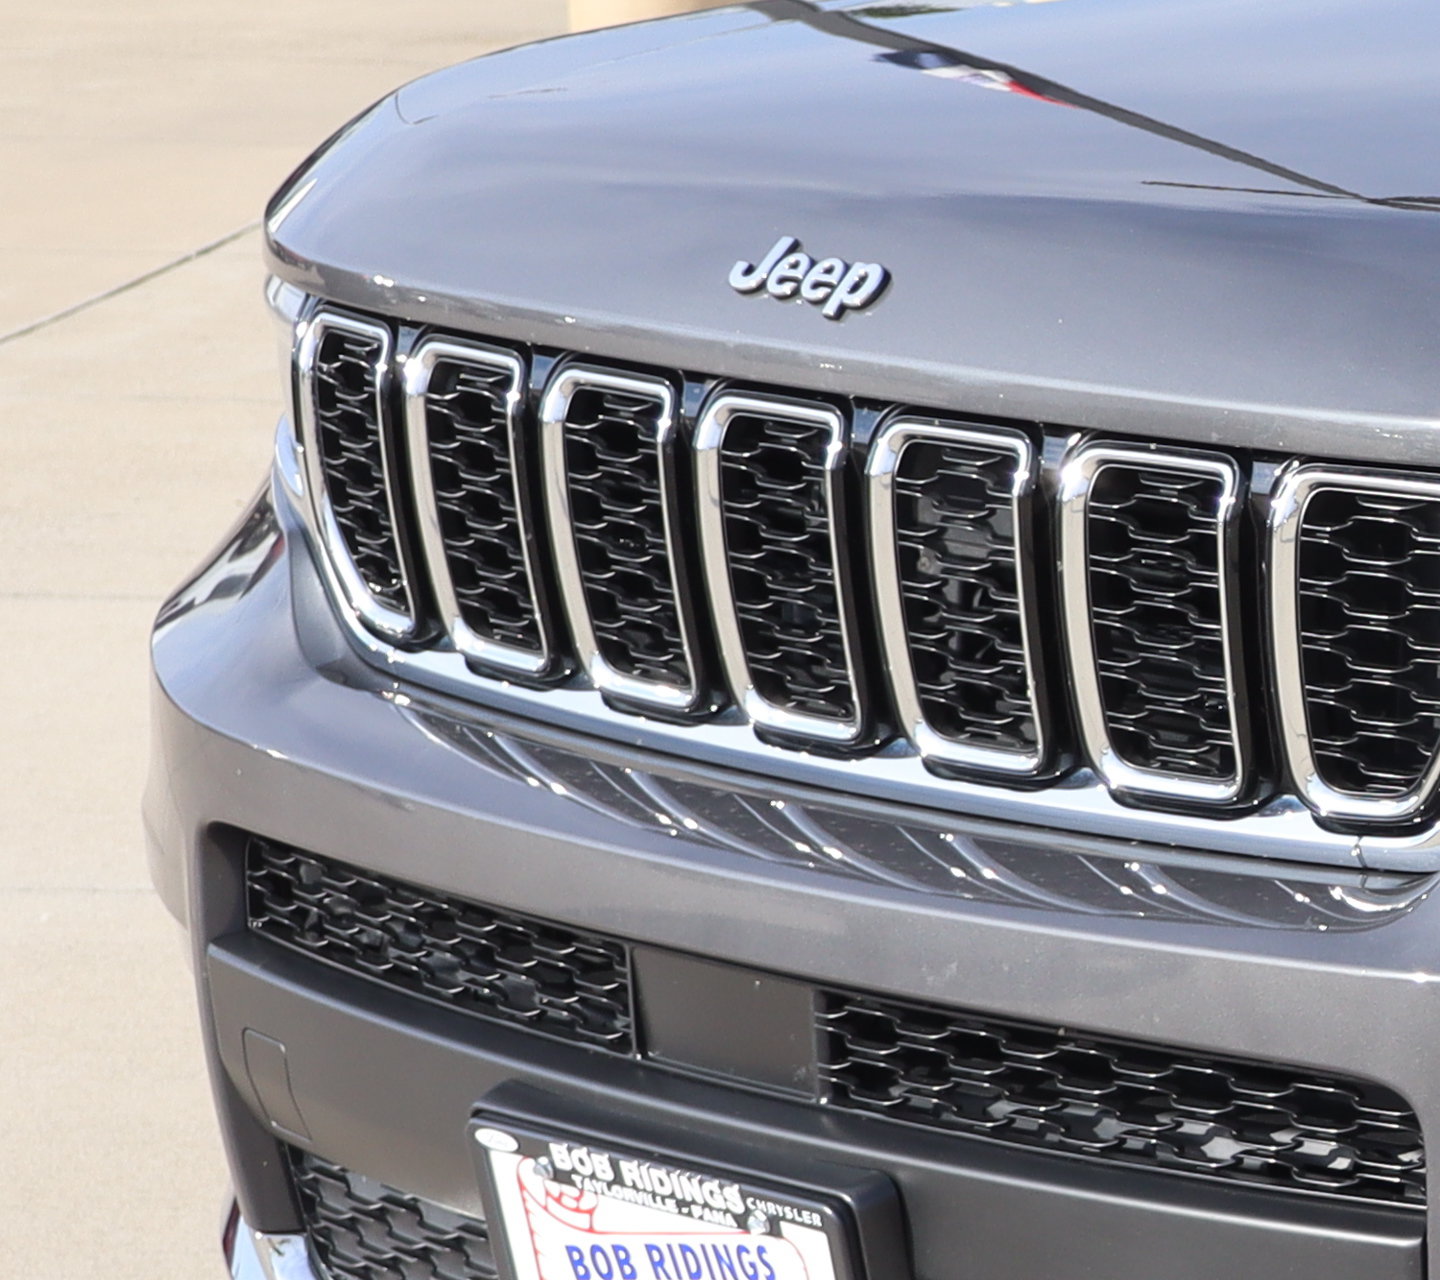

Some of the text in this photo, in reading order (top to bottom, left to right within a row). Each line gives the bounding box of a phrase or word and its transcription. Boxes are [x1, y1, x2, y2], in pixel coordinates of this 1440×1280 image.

[728, 235, 888, 319] Jeep
[548, 1142, 745, 1214] BOB RIDINGS
[571, 1173, 678, 1214] TAYLORVILLE
[690, 1206, 739, 1227] PANA
[746, 1197, 823, 1227] CHRYSLER
